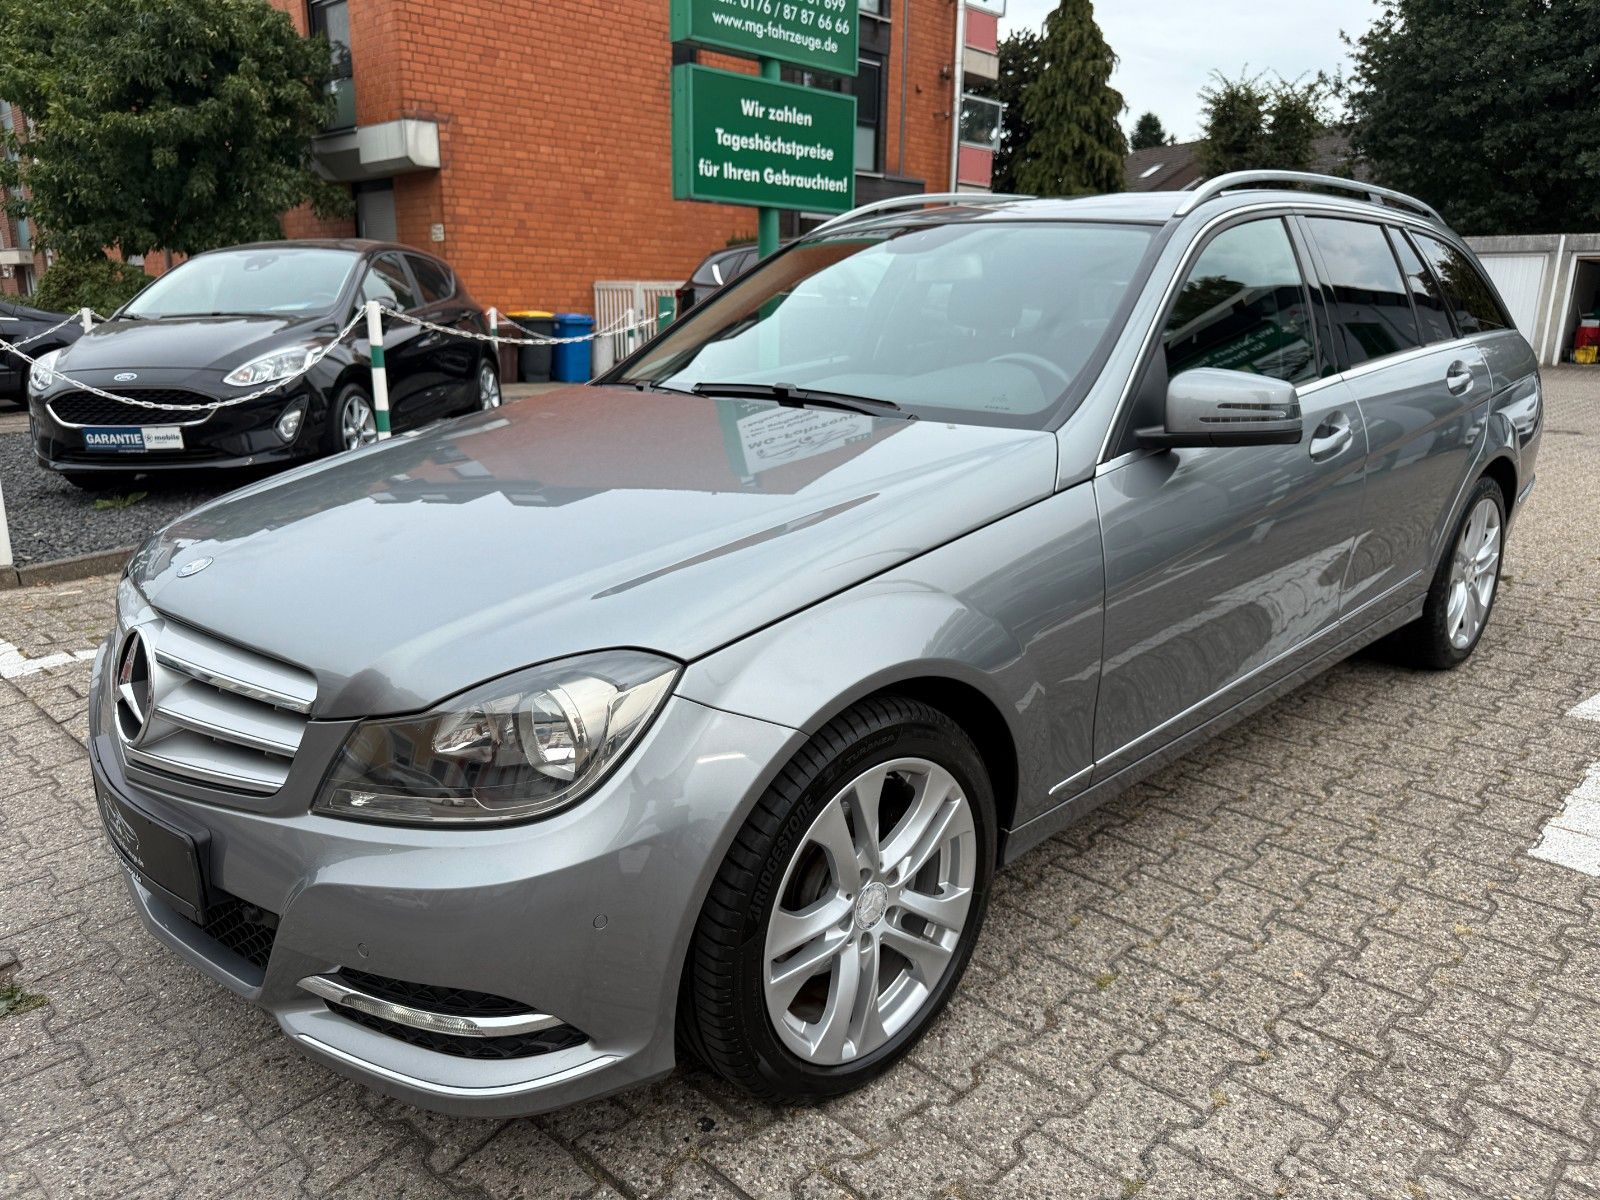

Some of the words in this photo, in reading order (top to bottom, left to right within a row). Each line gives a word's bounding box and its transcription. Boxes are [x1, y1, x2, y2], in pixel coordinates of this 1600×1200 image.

[712, 12, 838, 53] www.mg-fahrzeuge.de
[783, 3, 798, 21] 87
[800, 8, 816, 26] 87
[817, 14, 833, 31] 66
[835, 18, 850, 35] 66
[741, 98, 766, 119] Wir
[768, 105, 813, 127] zahlen
[715, 128, 834, 161] Tageshöchstpreise
[698, 158, 720, 178] für
[723, 162, 760, 183] Ihren
[763, 167, 848, 193] Gebrauchten!
[86, 433, 143, 445] GARANTIE
